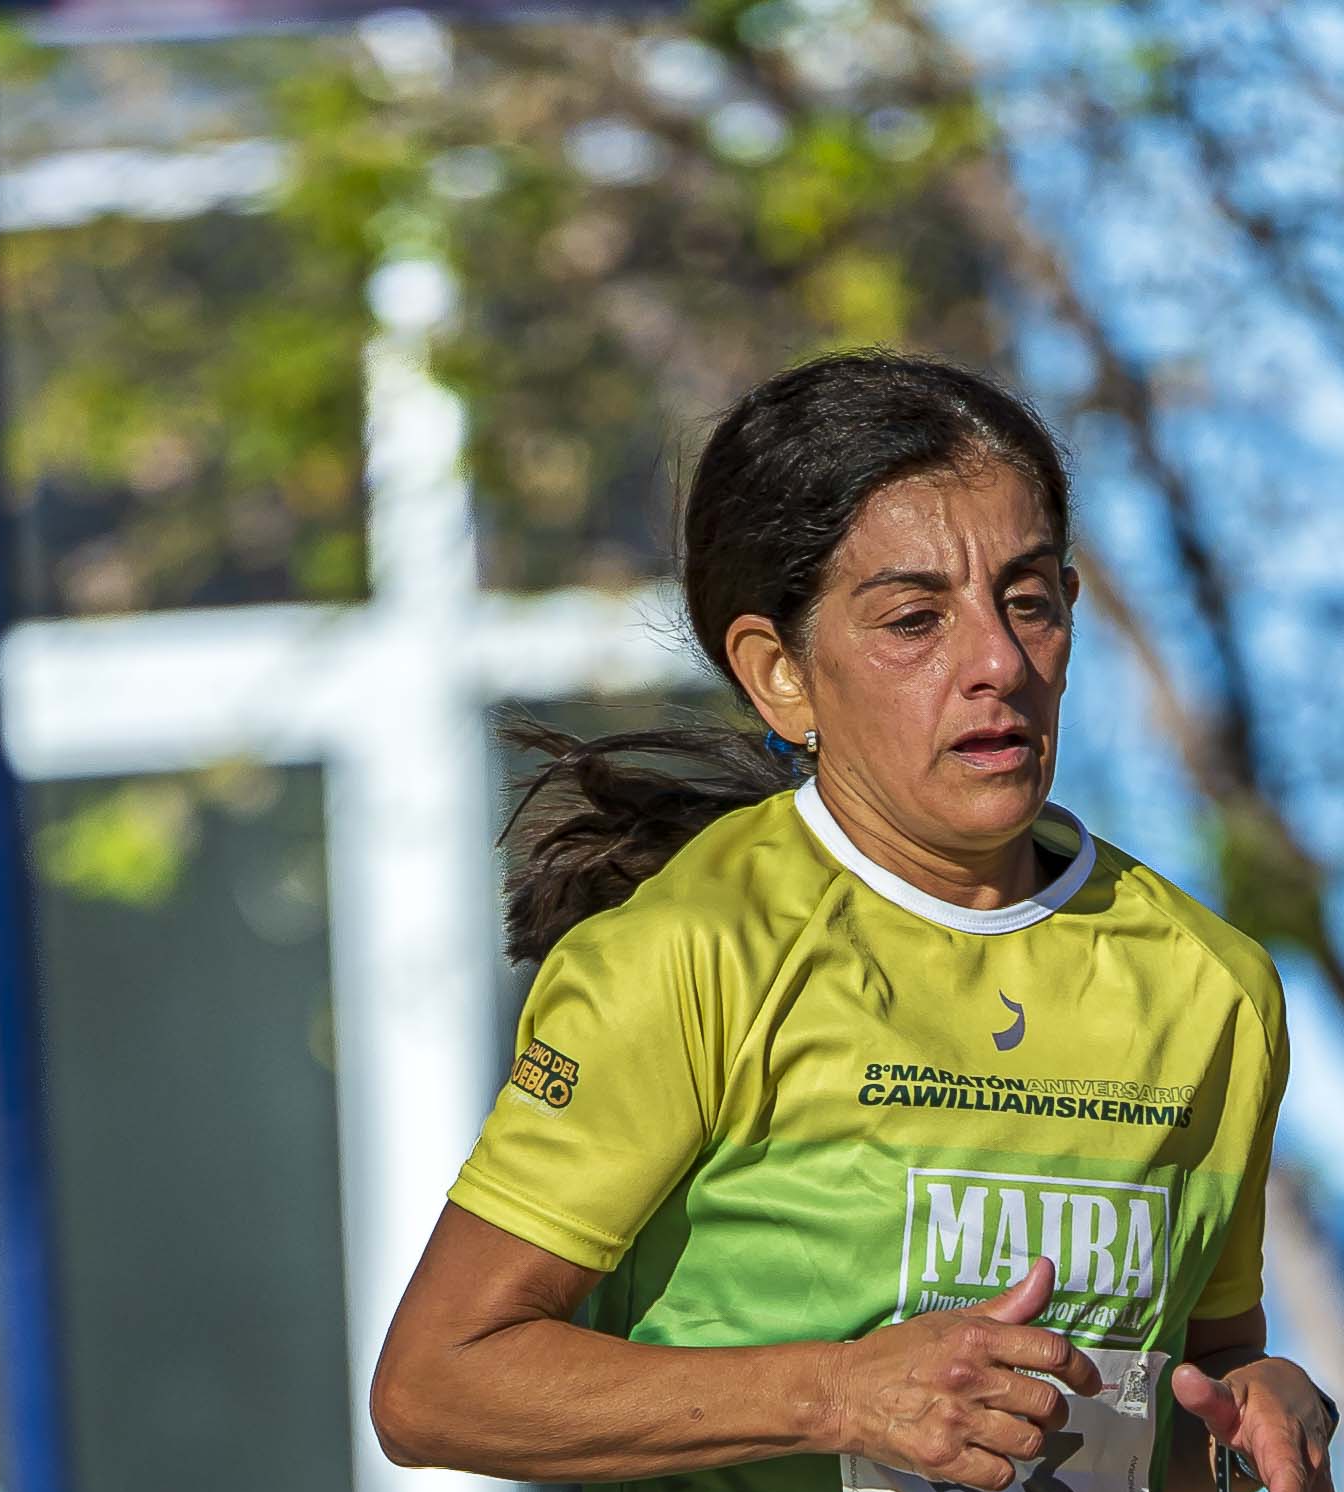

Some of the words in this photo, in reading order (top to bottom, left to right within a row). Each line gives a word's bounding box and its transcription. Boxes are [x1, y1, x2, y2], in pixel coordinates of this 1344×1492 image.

[512, 1058, 570, 1105] UEBLO
[551, 1056, 576, 1082] DEL
[921, 1183, 1154, 1299] MAIRA
[1038, 1301, 1118, 1328] yoristas
